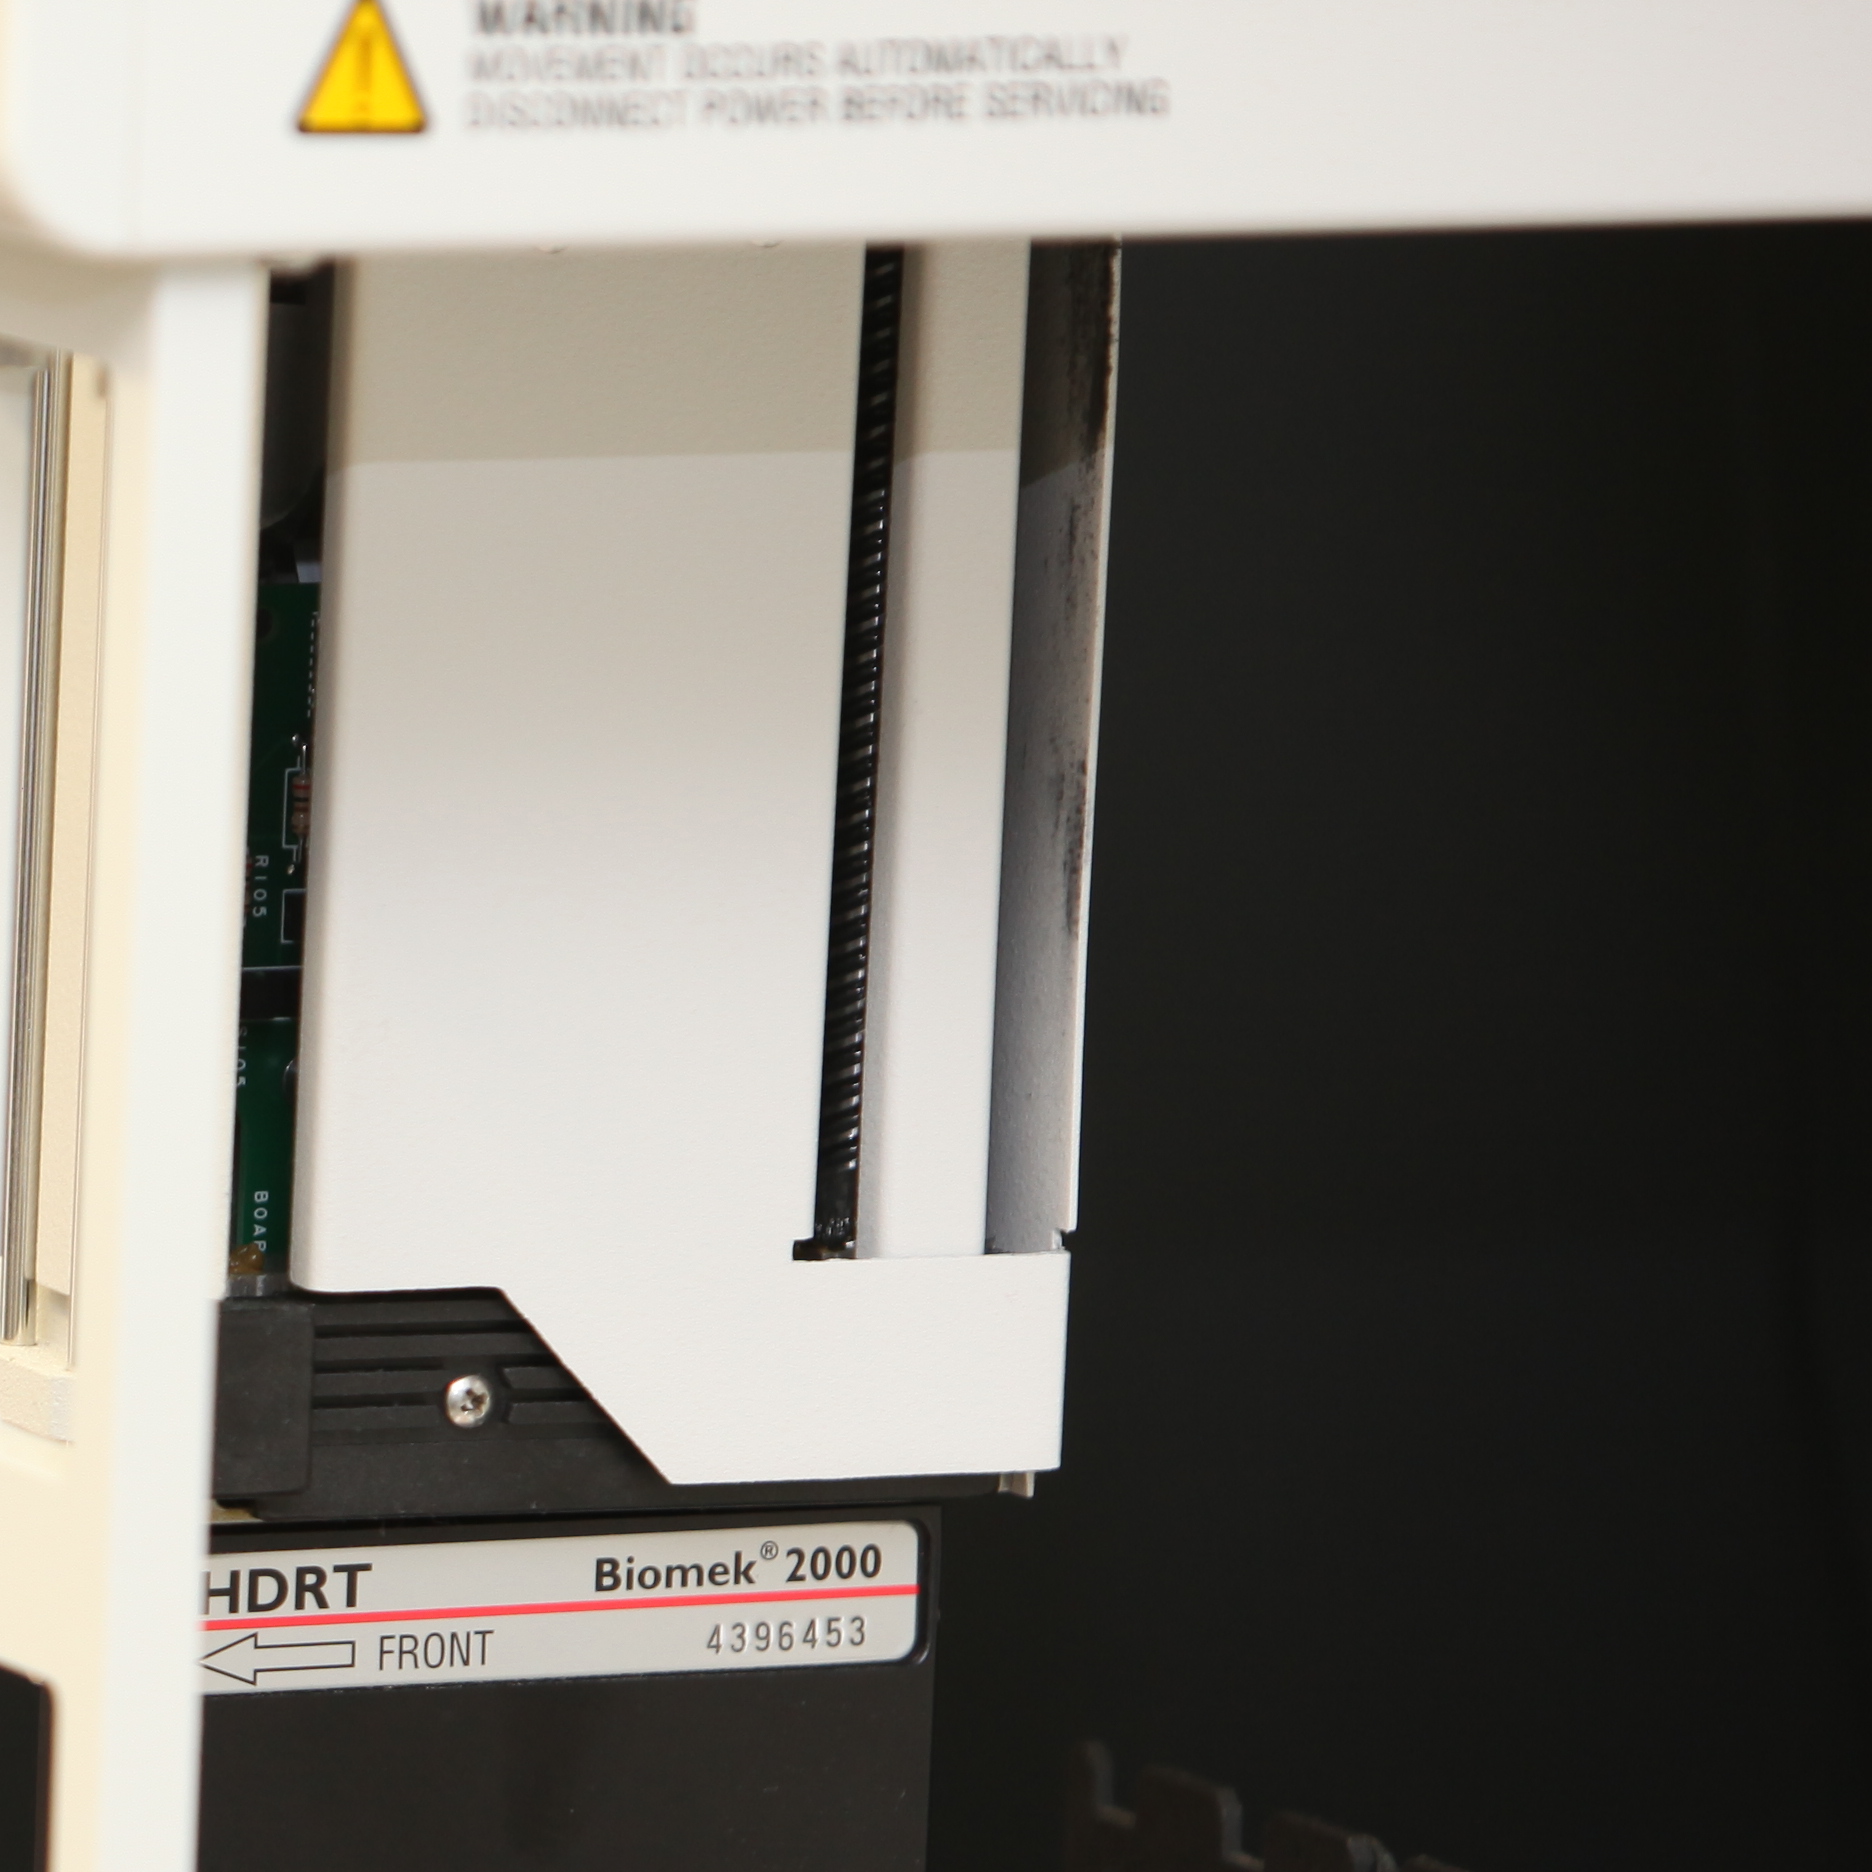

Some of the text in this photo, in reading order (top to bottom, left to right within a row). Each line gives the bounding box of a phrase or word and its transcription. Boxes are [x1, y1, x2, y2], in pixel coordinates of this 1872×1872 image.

[473, 0, 698, 34] WARNING
[467, 33, 1128, 79] MOVEMENT OCCURS AUTOMATICALLY
[466, 76, 1170, 127] DISCONNECT POWER BEFORE SERVICING
[204, 1563, 372, 1615] HDRT
[786, 1544, 883, 1583] 2000
[379, 1616, 867, 1671] FRONT 4396453
